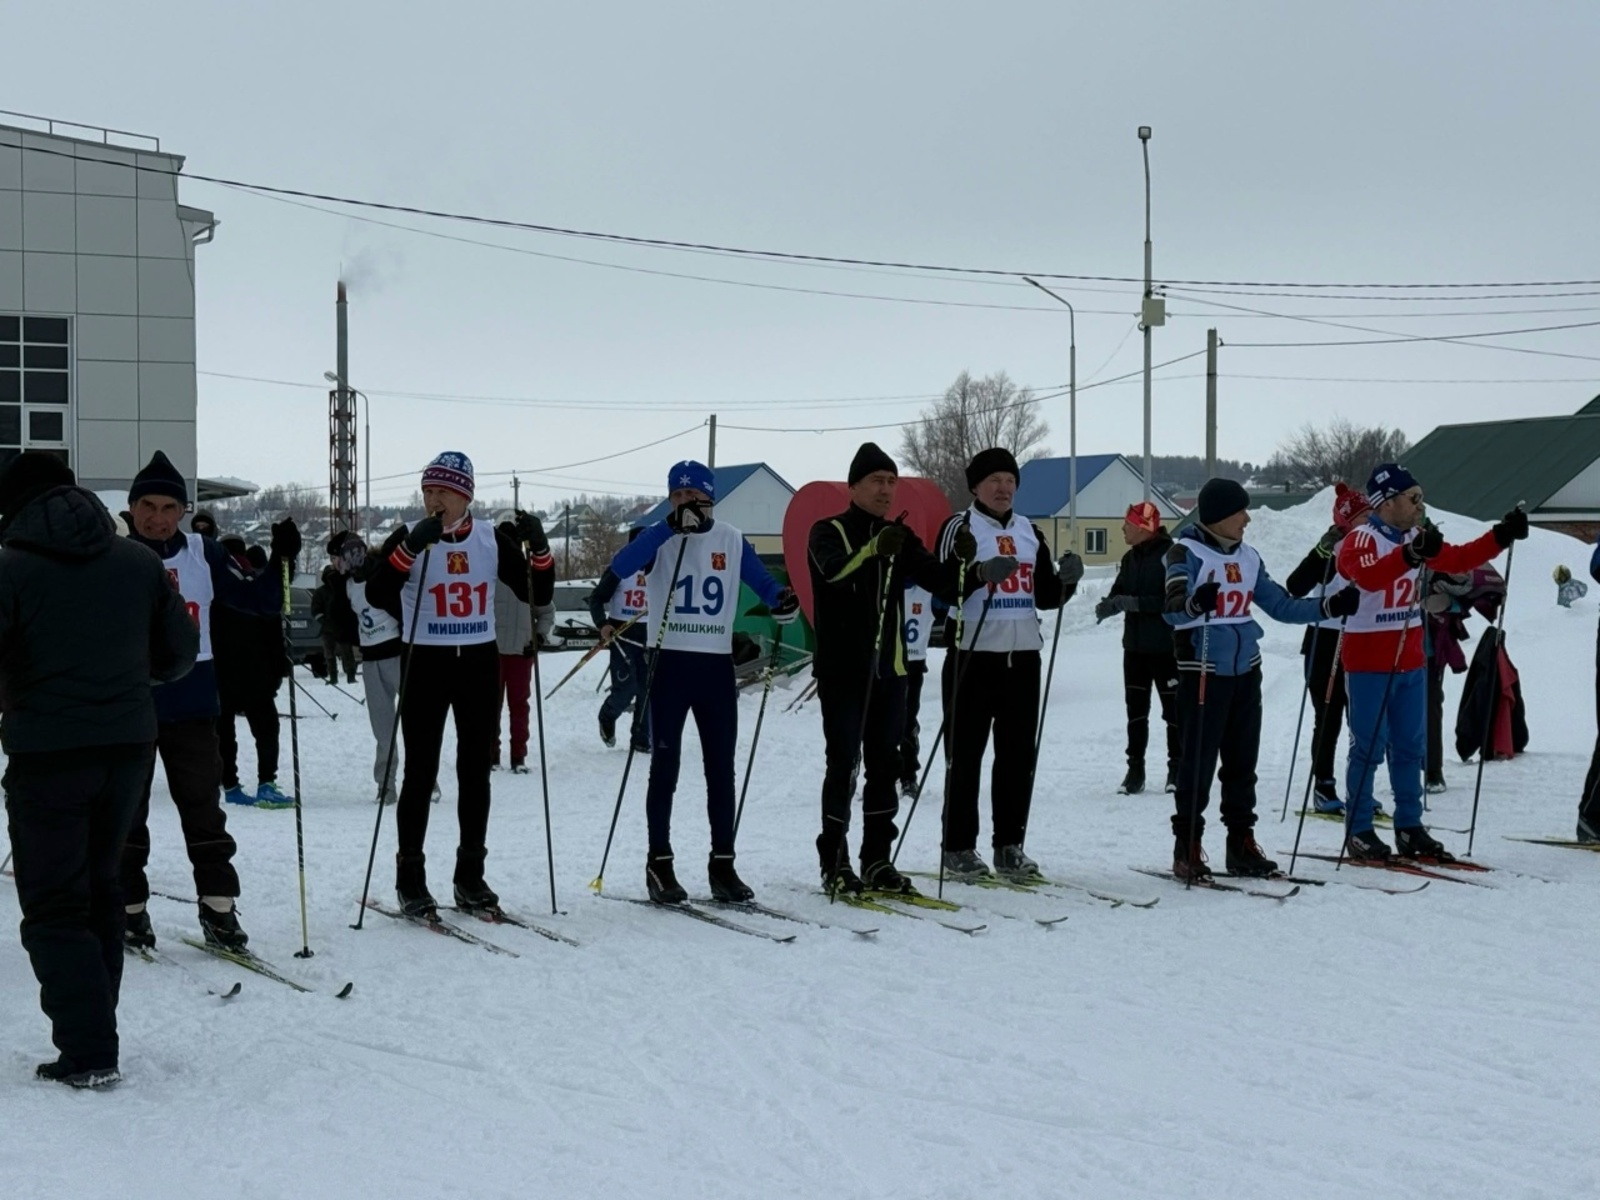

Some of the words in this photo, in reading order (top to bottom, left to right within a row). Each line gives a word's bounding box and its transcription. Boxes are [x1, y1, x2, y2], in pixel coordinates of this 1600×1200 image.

[428, 582, 488, 618] 131
[623, 589, 648, 609] 13
[674, 575, 725, 616] 19
[361, 608, 375, 629] 5
[427, 620, 489, 635] МИШКИНО
[668, 622, 726, 635] МИШКИНО
[905, 618, 920, 644] 6
